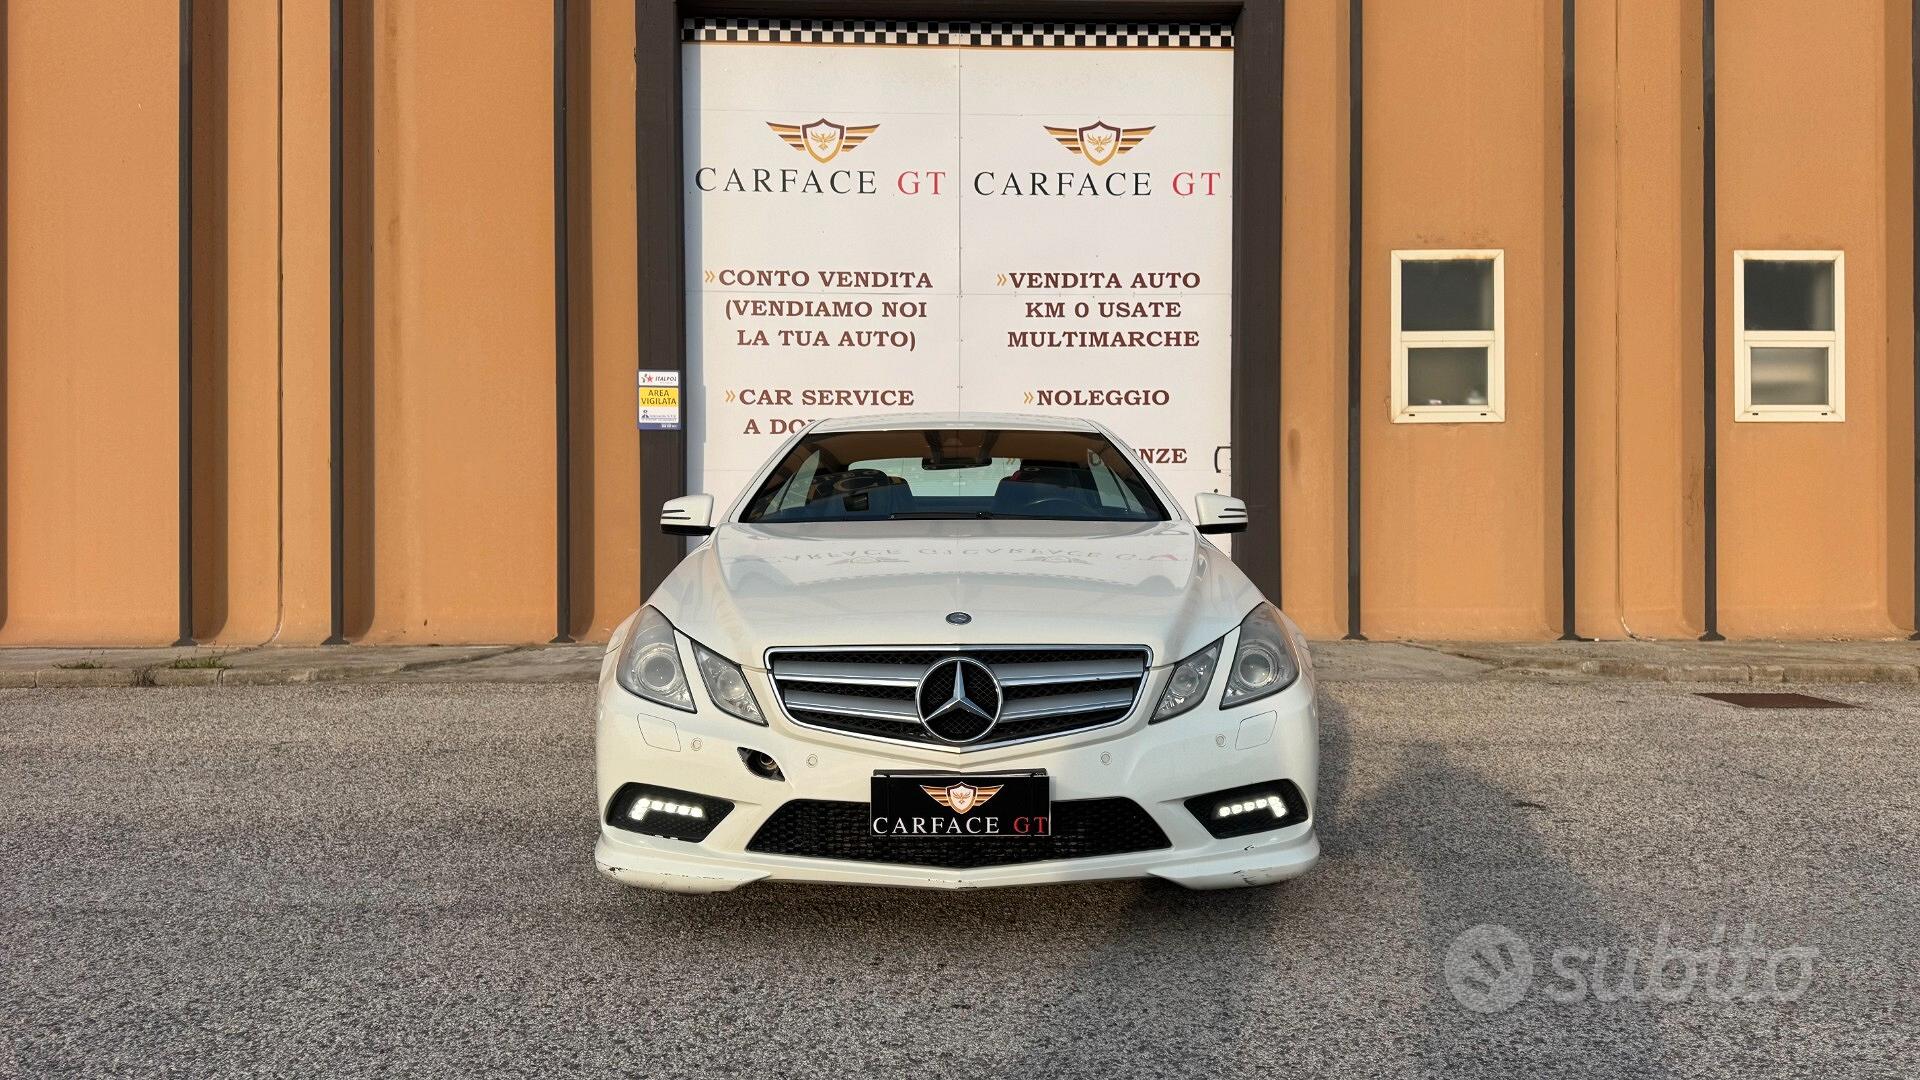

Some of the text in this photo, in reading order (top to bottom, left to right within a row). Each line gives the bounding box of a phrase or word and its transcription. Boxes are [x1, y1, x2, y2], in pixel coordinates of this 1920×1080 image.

[695, 167, 946, 196] CARFACE GT
[973, 171, 1221, 197] CARFACE GT
[718, 269, 934, 289] CONTO VENDITA
[1008, 271, 1201, 289] VENDITA AUTO
[725, 299, 927, 321] (VENDIAMO NOI
[1025, 301, 1066, 318] KM
[1098, 301, 1182, 319] USATE
[736, 329, 916, 352] LA TUA AUTO)
[1007, 330, 1200, 348] MULTIMARCHE
[640, 397, 677, 405] VIGILATA
[647, 389, 670, 397] AREA
[739, 388, 915, 406] CAR SERVICE
[1036, 389, 1170, 406] NOLEGGIO
[743, 418, 816, 435] A DO
[1131, 447, 1188, 464] NZE
[872, 816, 1048, 834] CARFACE GT
